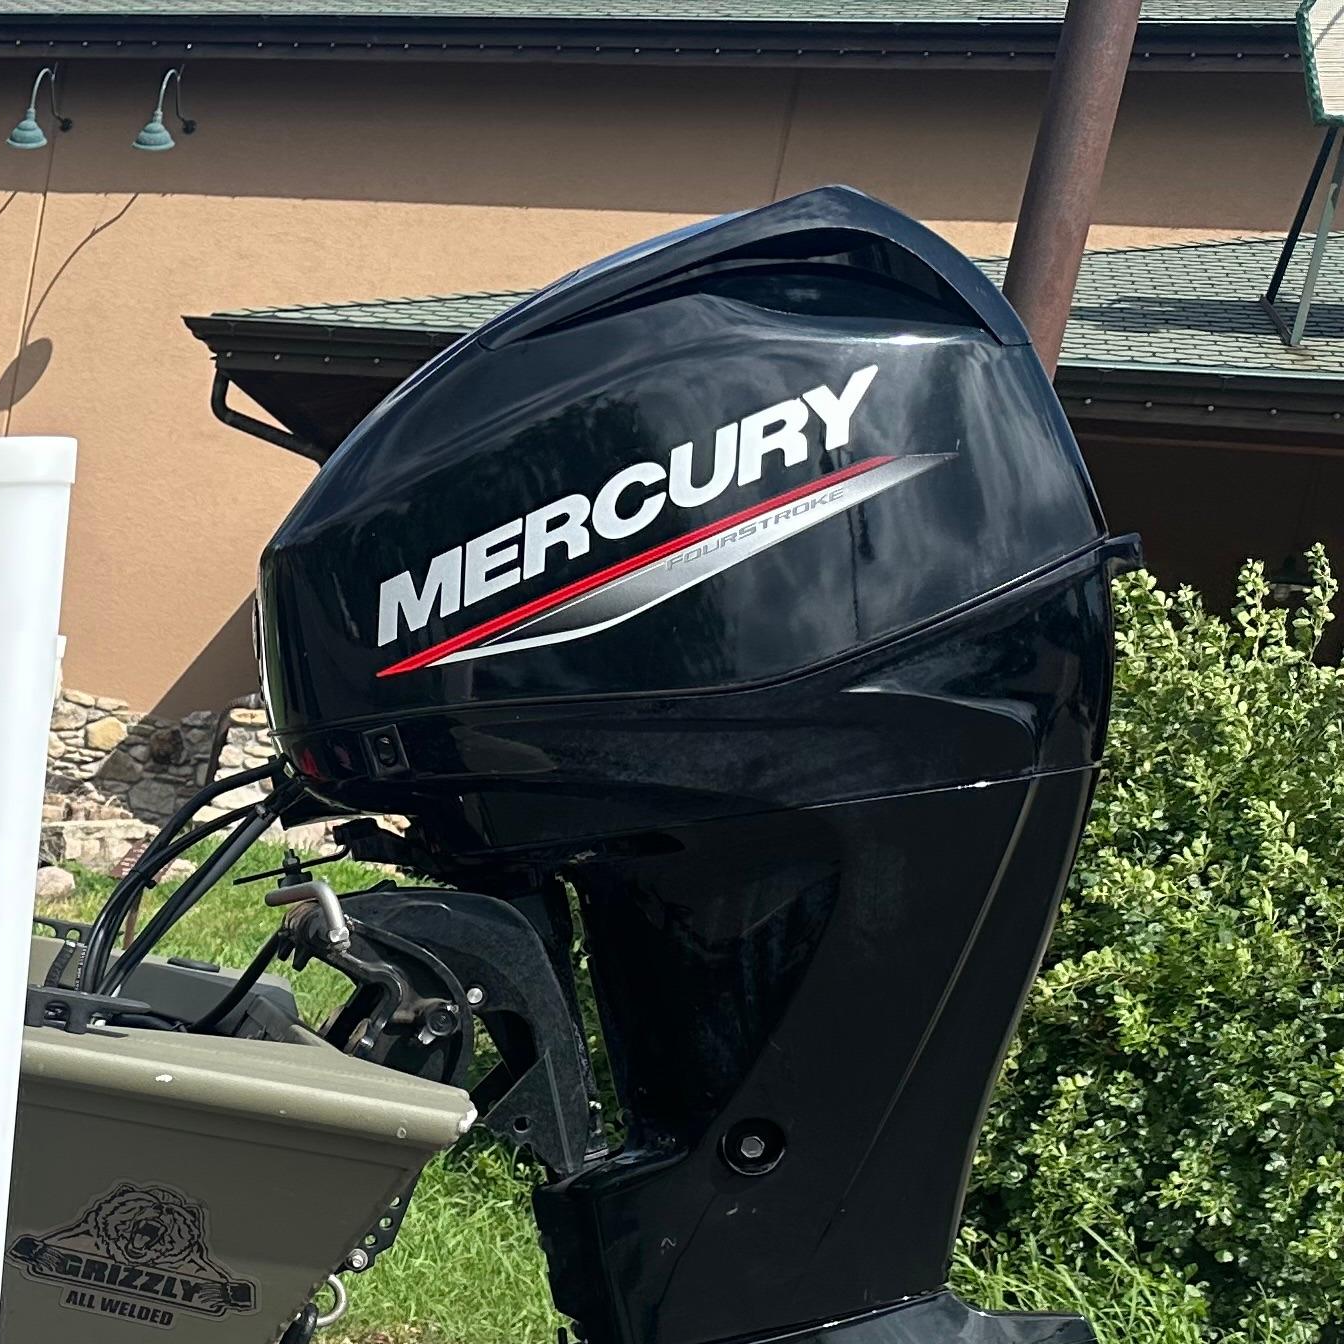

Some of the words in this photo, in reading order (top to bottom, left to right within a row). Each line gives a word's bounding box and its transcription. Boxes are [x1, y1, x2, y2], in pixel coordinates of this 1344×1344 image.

[377, 363, 879, 648] MERCURY
[666, 487, 844, 570] FOURSTROKE
[61, 1254, 204, 1303] GRIZZLY
[65, 1290, 95, 1310] ALL
[100, 1296, 174, 1327] WELDED
